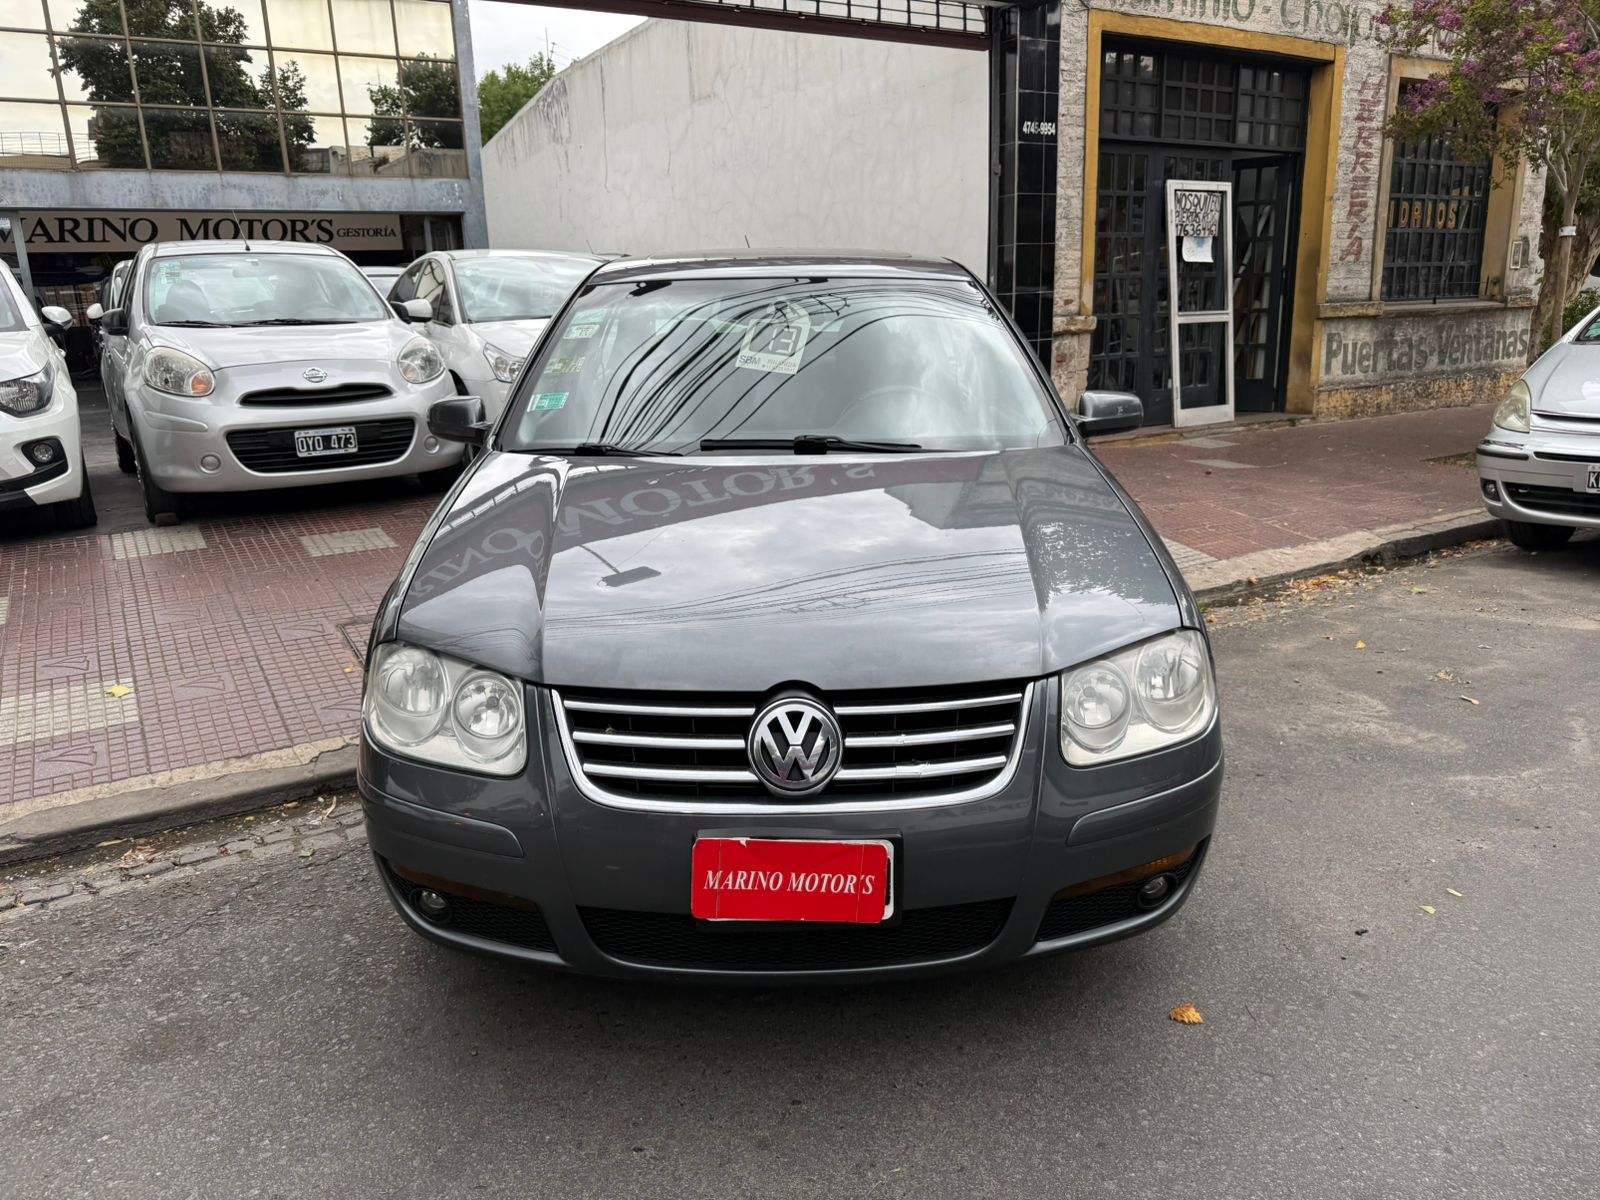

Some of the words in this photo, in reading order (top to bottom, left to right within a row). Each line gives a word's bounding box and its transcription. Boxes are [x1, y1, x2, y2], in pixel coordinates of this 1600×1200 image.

[1022, 121, 1056, 136] 4745-9954
[1339, 74, 1387, 261] HERRERIA
[1388, 201, 1459, 231] IDRIOS
[176, 217, 334, 243] MOTOR'S
[336, 225, 397, 238] GESTORÍA
[298, 436, 324, 452] OYO
[330, 433, 356, 450] 473
[1588, 471, 1600, 489] K
[703, 869, 784, 891] MARINO
[786, 872, 876, 895] MOTOR'S
